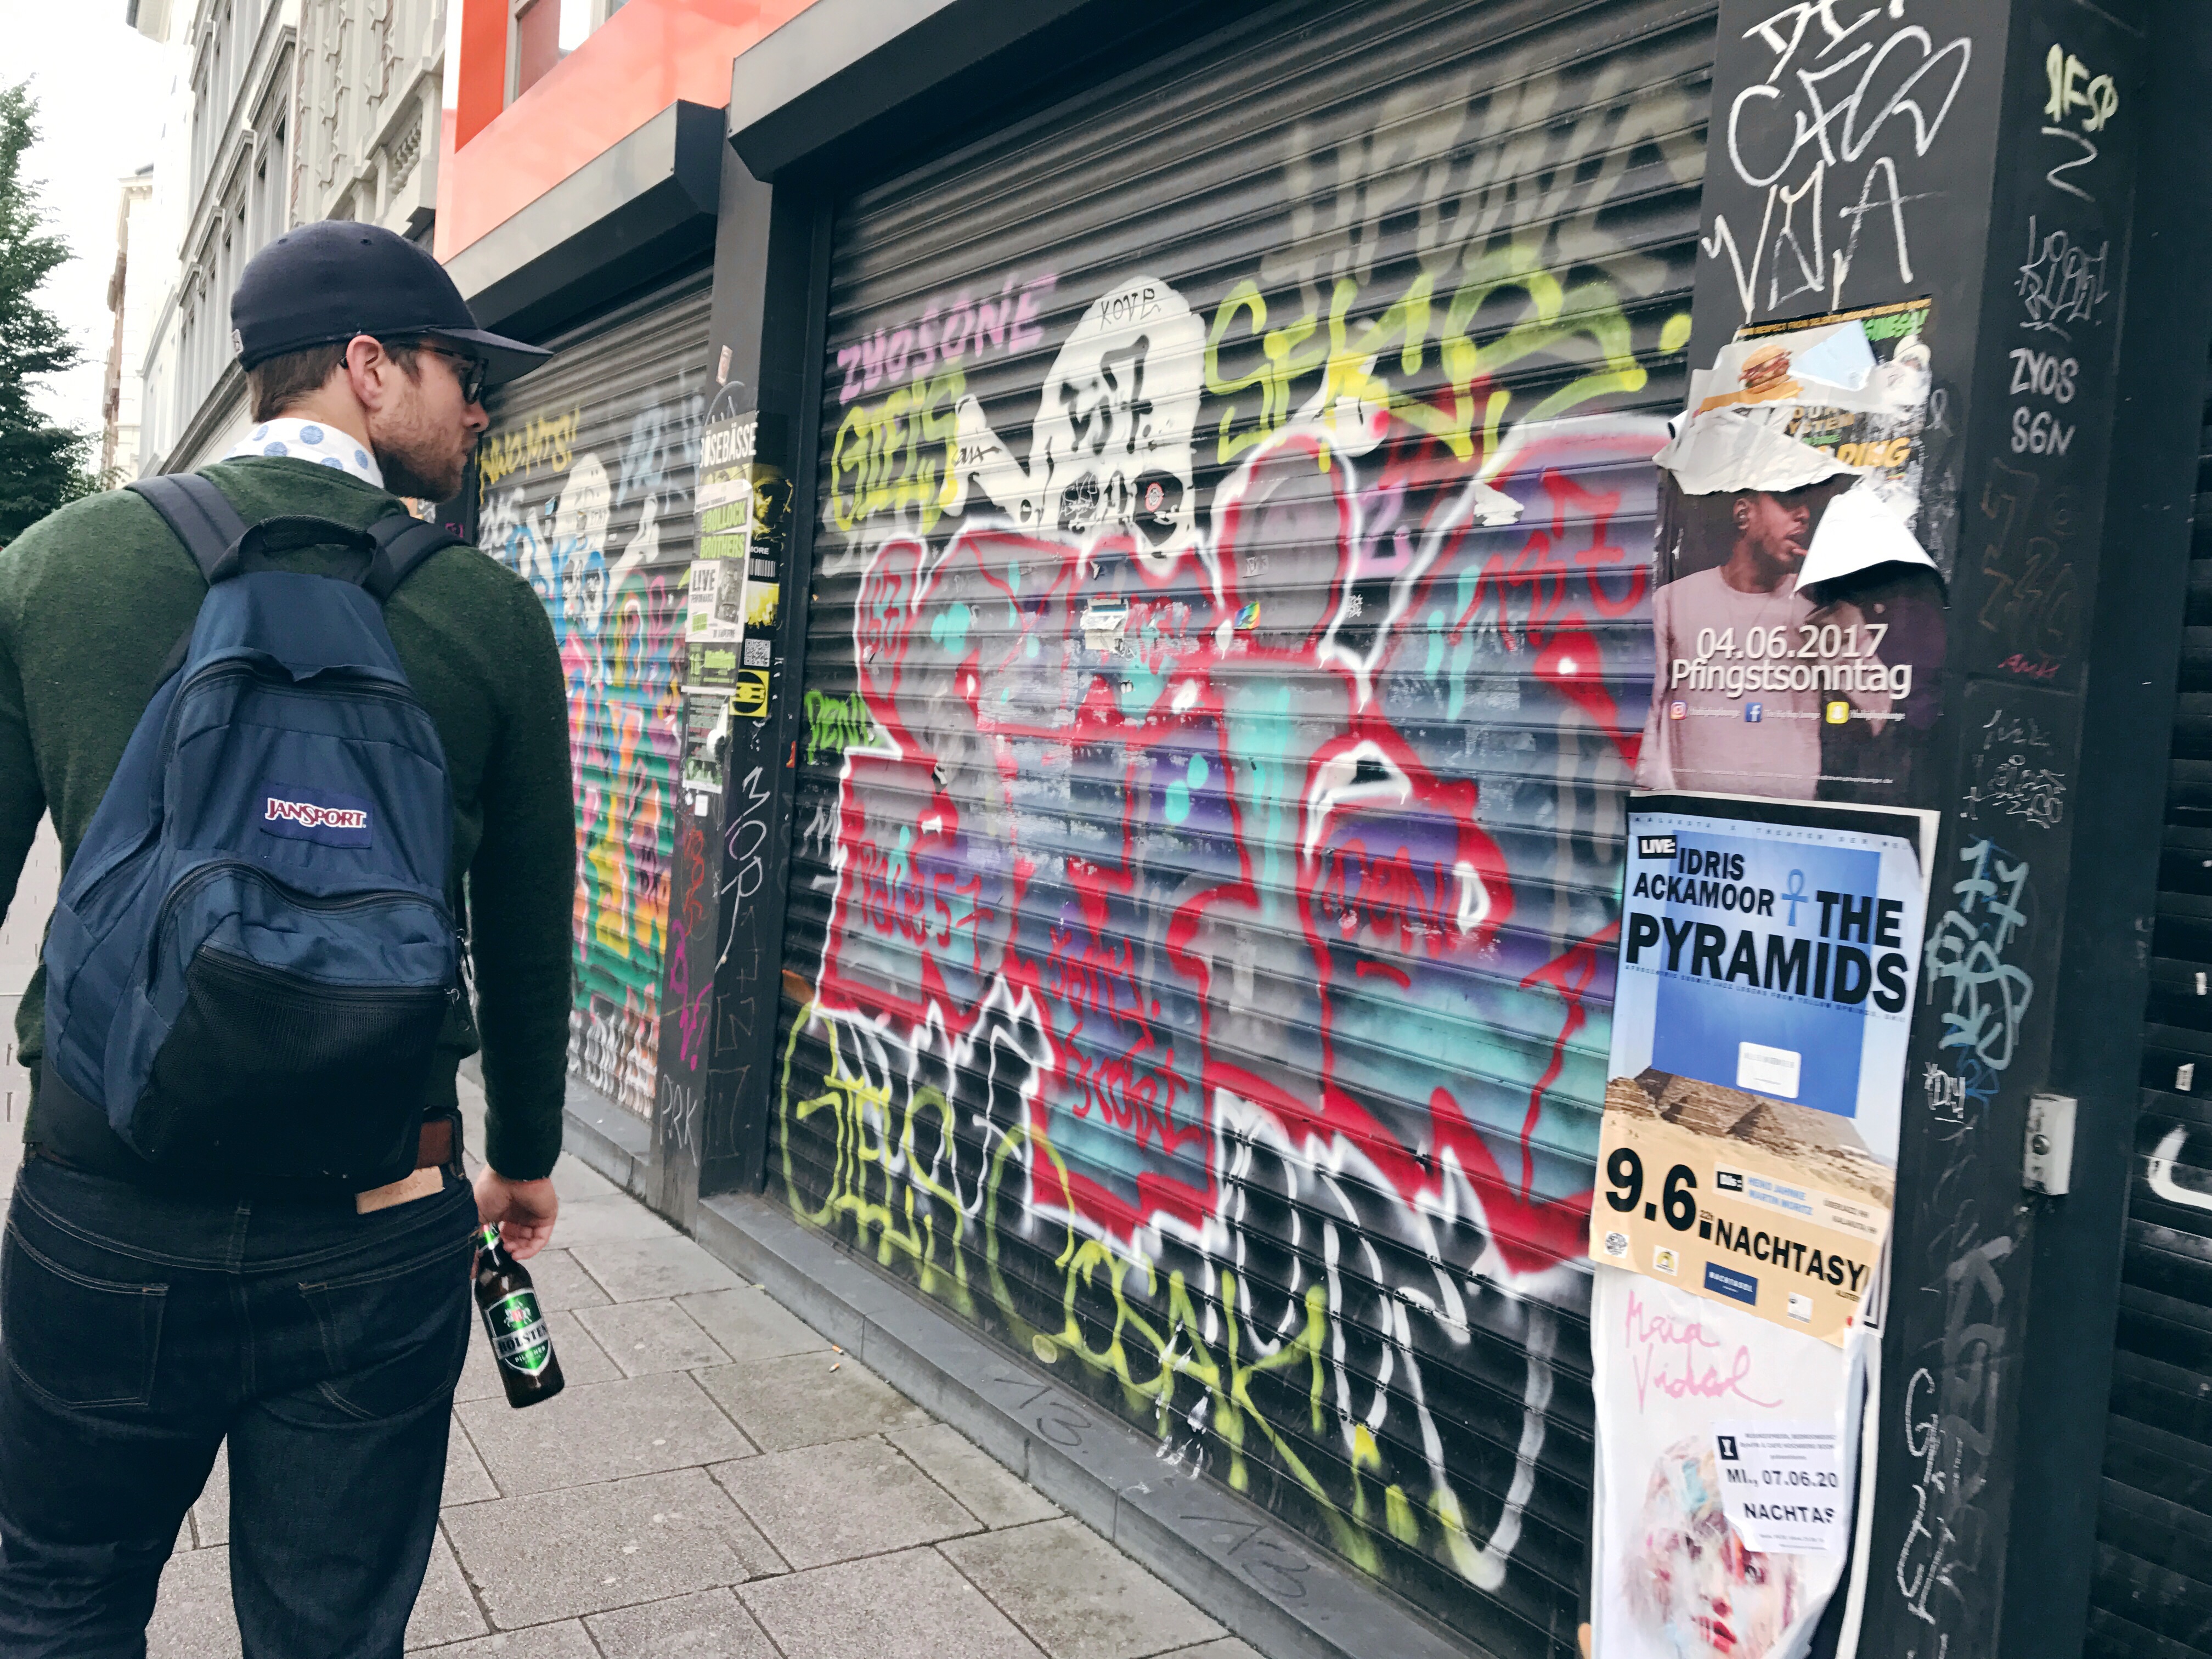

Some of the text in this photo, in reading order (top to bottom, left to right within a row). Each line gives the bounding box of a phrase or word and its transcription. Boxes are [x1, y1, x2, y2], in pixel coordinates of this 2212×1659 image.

[1696, 623, 1888, 660] 04.06.2017
[1671, 659, 1912, 699] Pfingstsonntag
[265, 797, 366, 828] JANSPORT
[1678, 847, 1746, 881] IDRIS
[1633, 872, 1775, 917] ACKAMOOR
[1816, 890, 1904, 949] THE
[1626, 912, 1910, 1014] PYRAMIDS
[1633, 1342, 1784, 1415] Vidal
[1762, 1469, 1839, 1488] 07.06.20
[1742, 1502, 1835, 1525] NACHTAS
